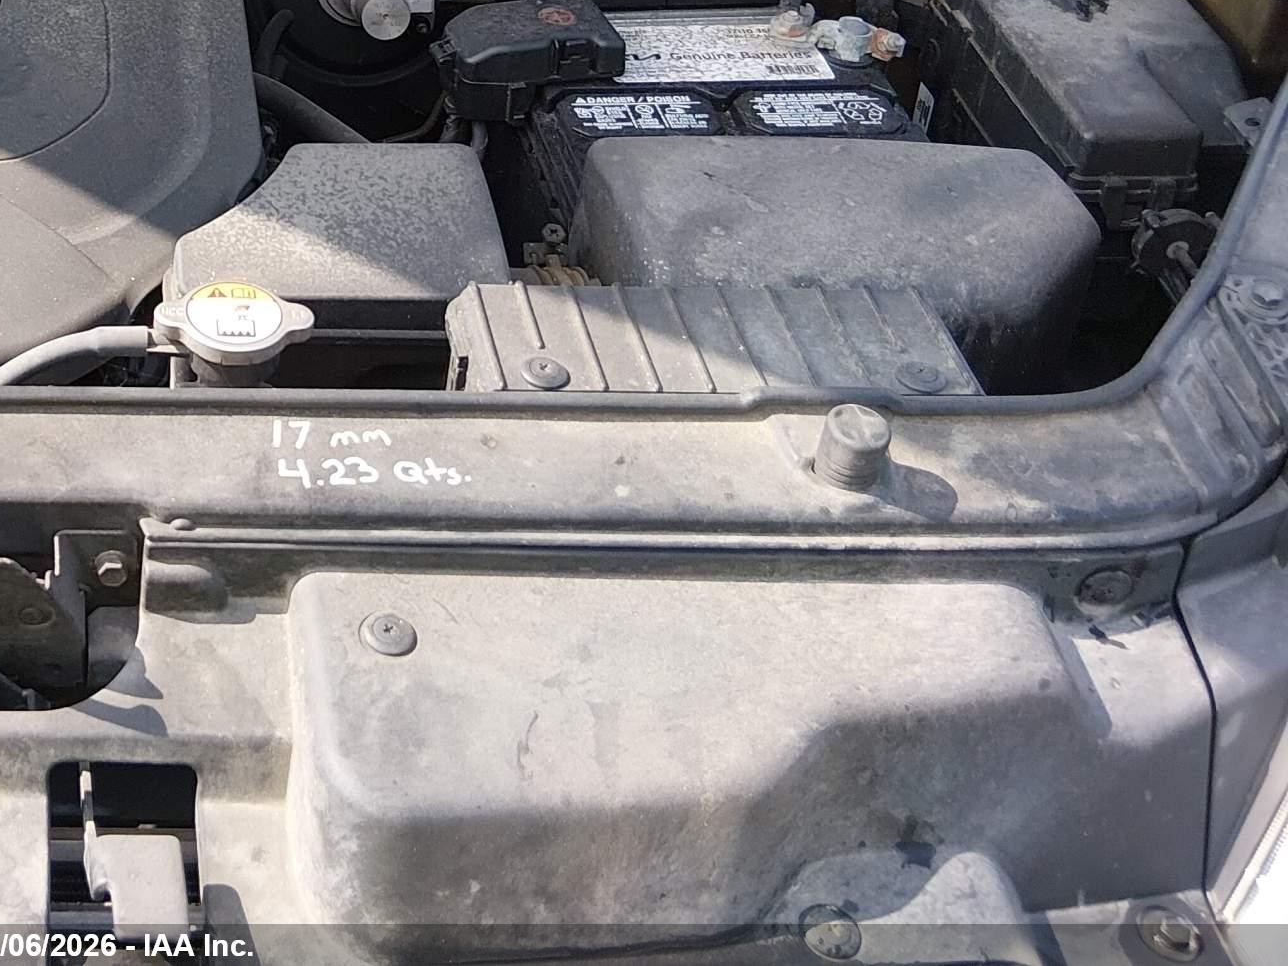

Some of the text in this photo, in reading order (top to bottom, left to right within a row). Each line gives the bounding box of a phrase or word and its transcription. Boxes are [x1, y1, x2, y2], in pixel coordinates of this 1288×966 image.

[669, 51, 735, 62] Genuine
[739, 50, 812, 62] Batteries
[587, 96, 636, 104] DANGER
[645, 95, 692, 103] POISON
[271, 419, 392, 449] 17 mm
[277, 456, 472, 489] 4.23 Qts.
